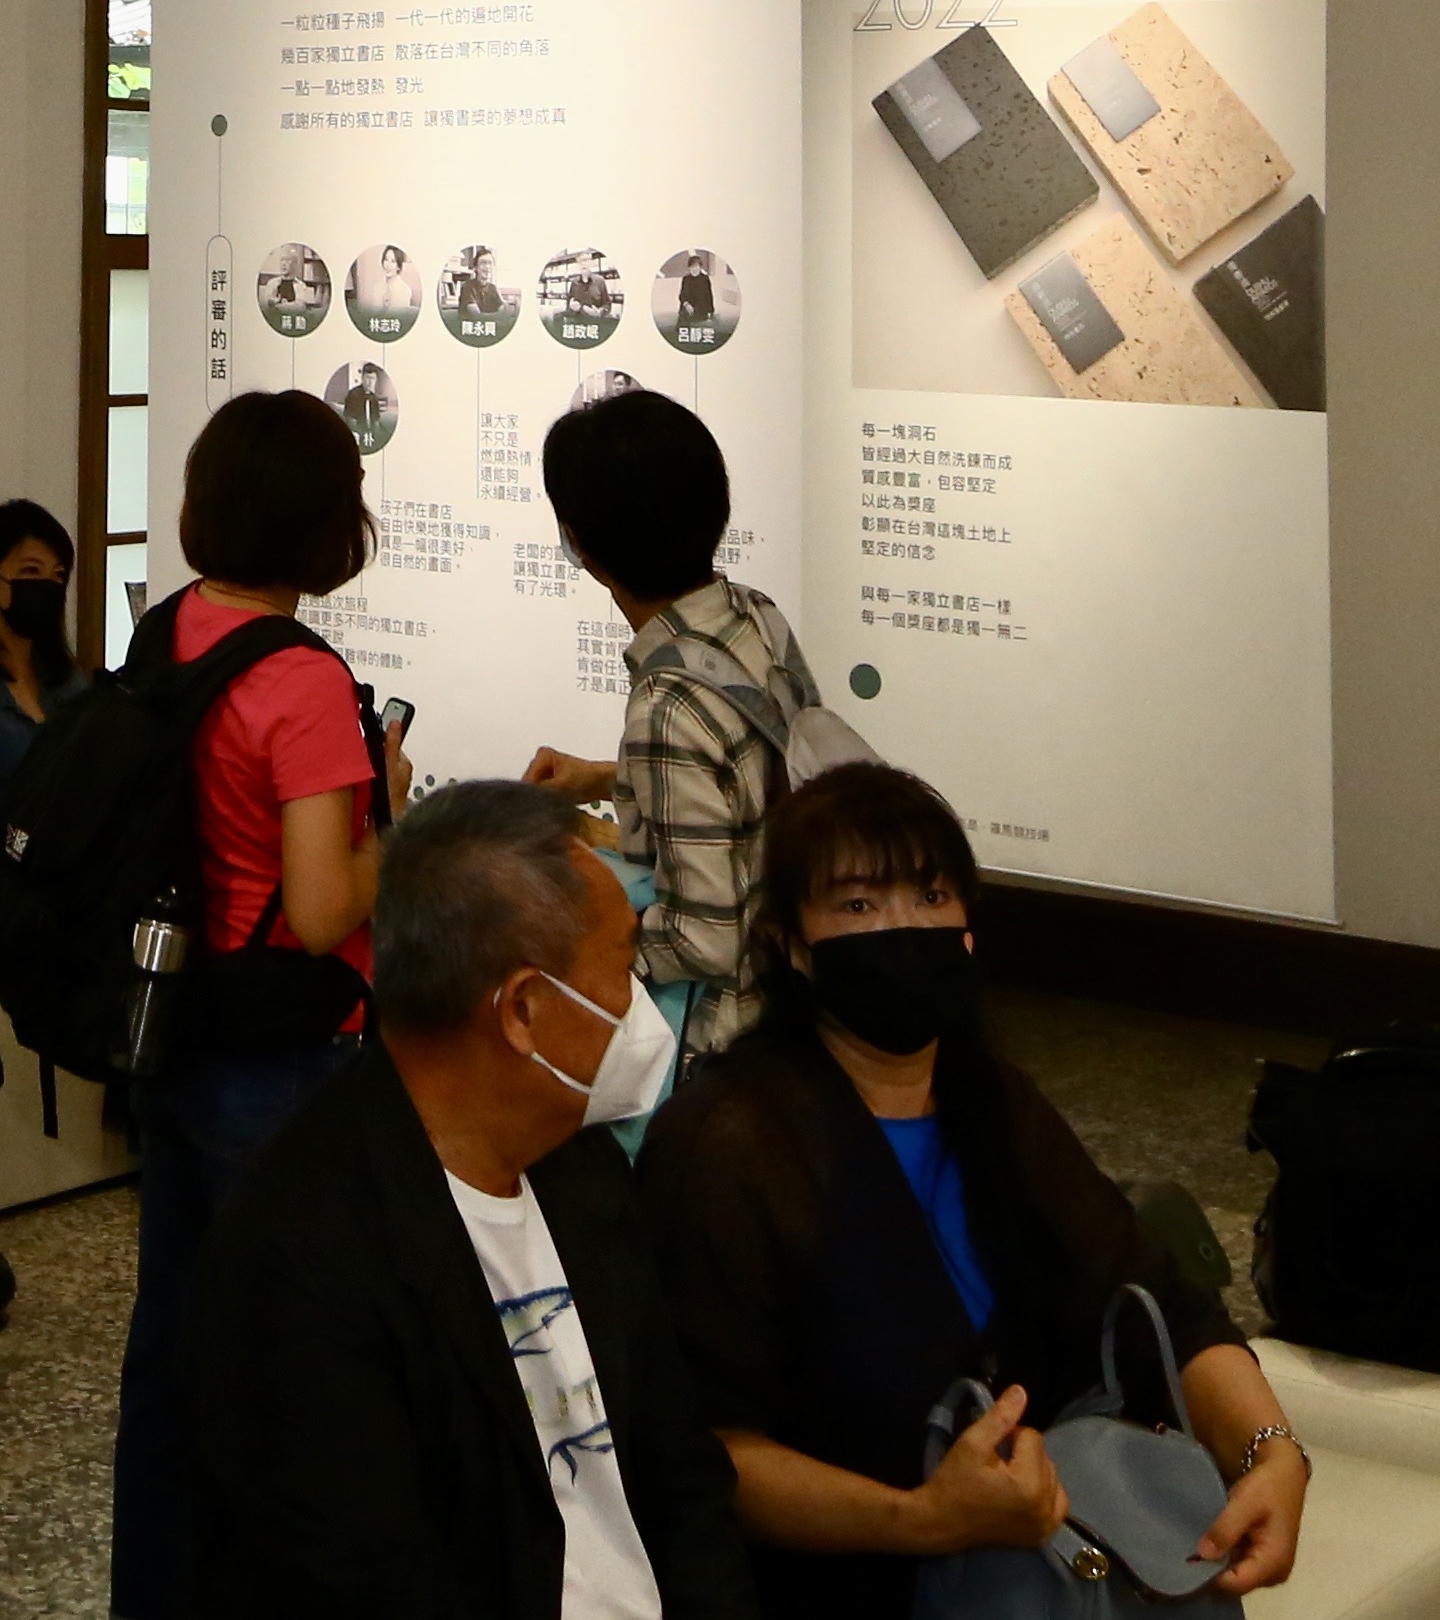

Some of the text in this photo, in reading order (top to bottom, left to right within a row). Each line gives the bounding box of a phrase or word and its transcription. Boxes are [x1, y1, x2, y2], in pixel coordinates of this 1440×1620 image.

[370, 318, 401, 333] 林志玲
[862, 422, 936, 441] 每一塊洞石
[862, 493, 936, 513] 以此為獎座
